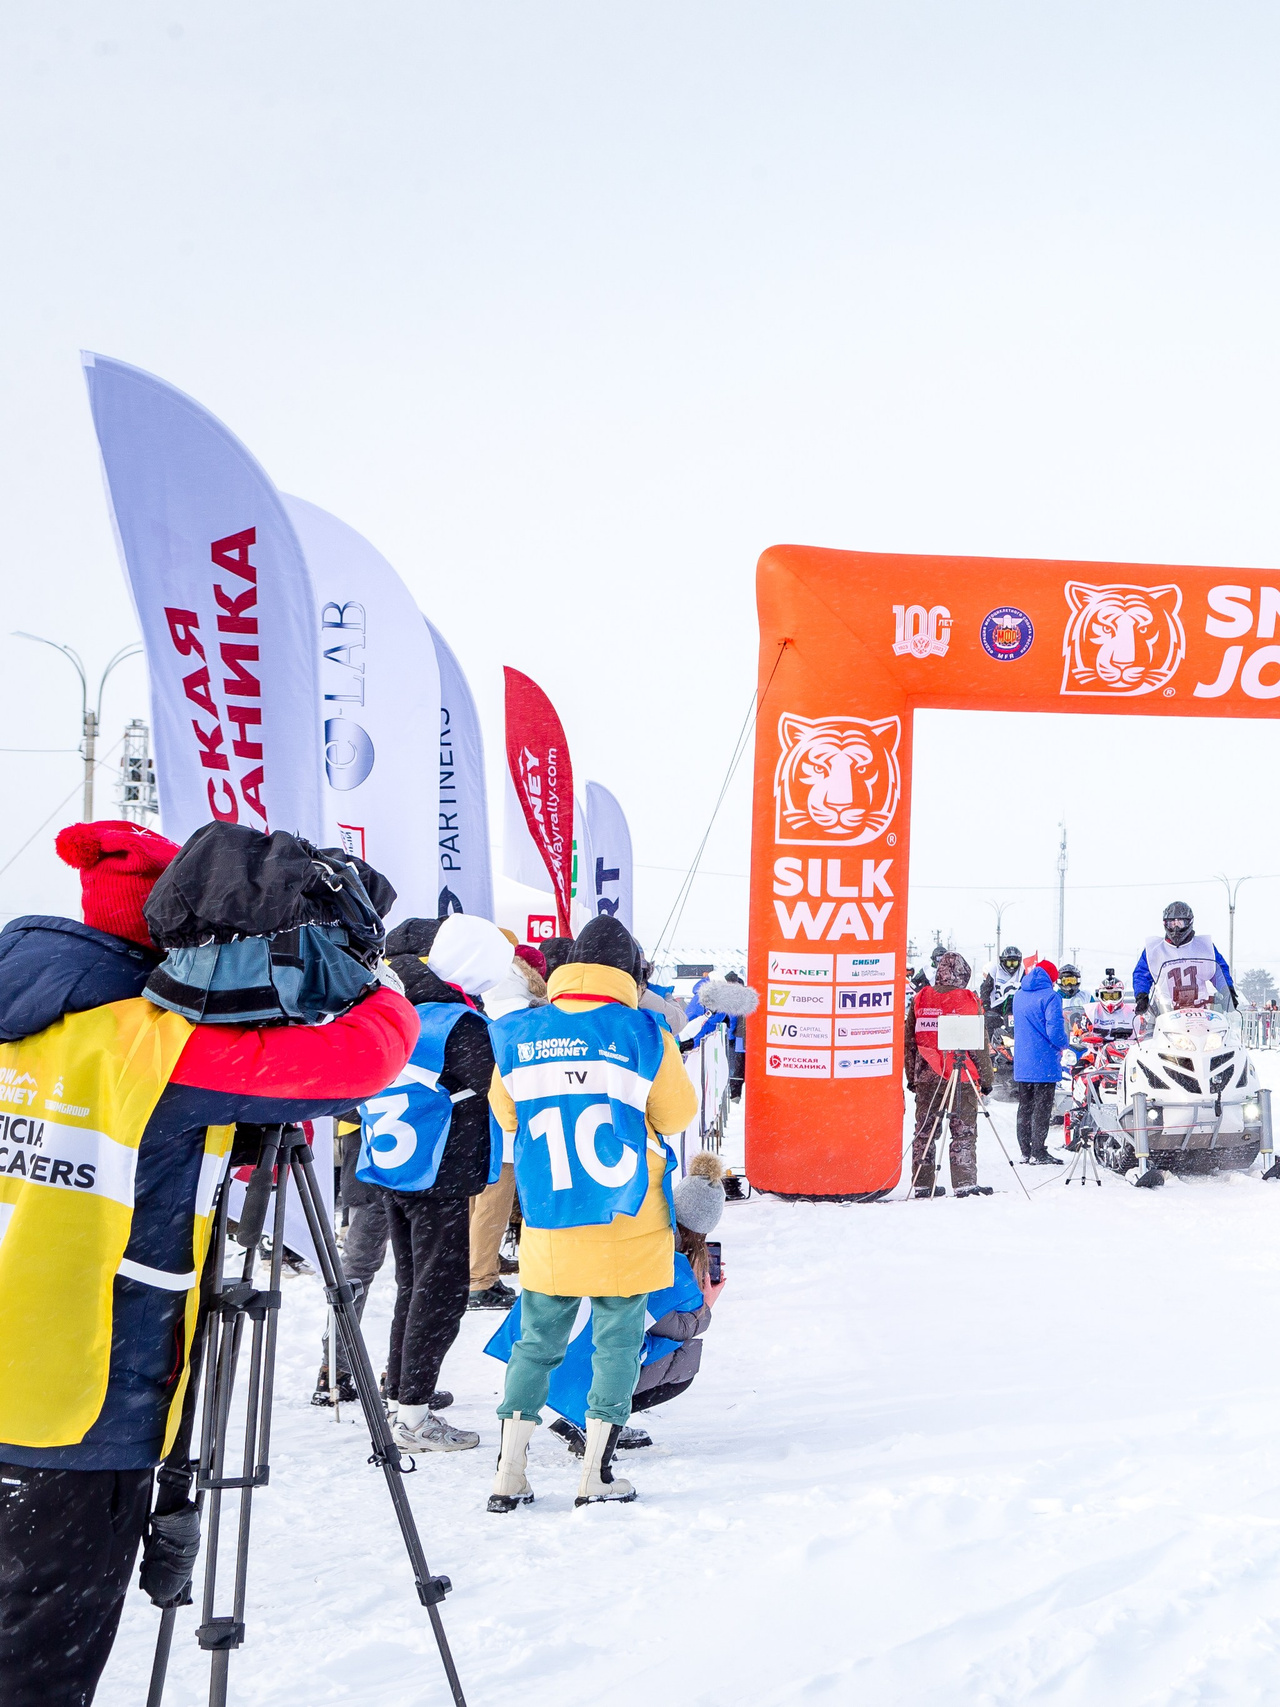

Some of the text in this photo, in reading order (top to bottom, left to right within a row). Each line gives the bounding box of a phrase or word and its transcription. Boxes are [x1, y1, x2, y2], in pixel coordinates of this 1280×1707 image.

[210, 526, 269, 836] АНИКА
[772, 856, 894, 898] SILK
[772, 899, 894, 941] WAY
[530, 919, 553, 939] 16
[780, 968, 829, 976] TATNEFT
[841, 991, 892, 1008] NART
[769, 1023, 797, 1037] AVG
[535, 1038, 570, 1051] SNOW
[535, 1047, 589, 1059] JOURNEY
[565, 1071, 588, 1085] TV
